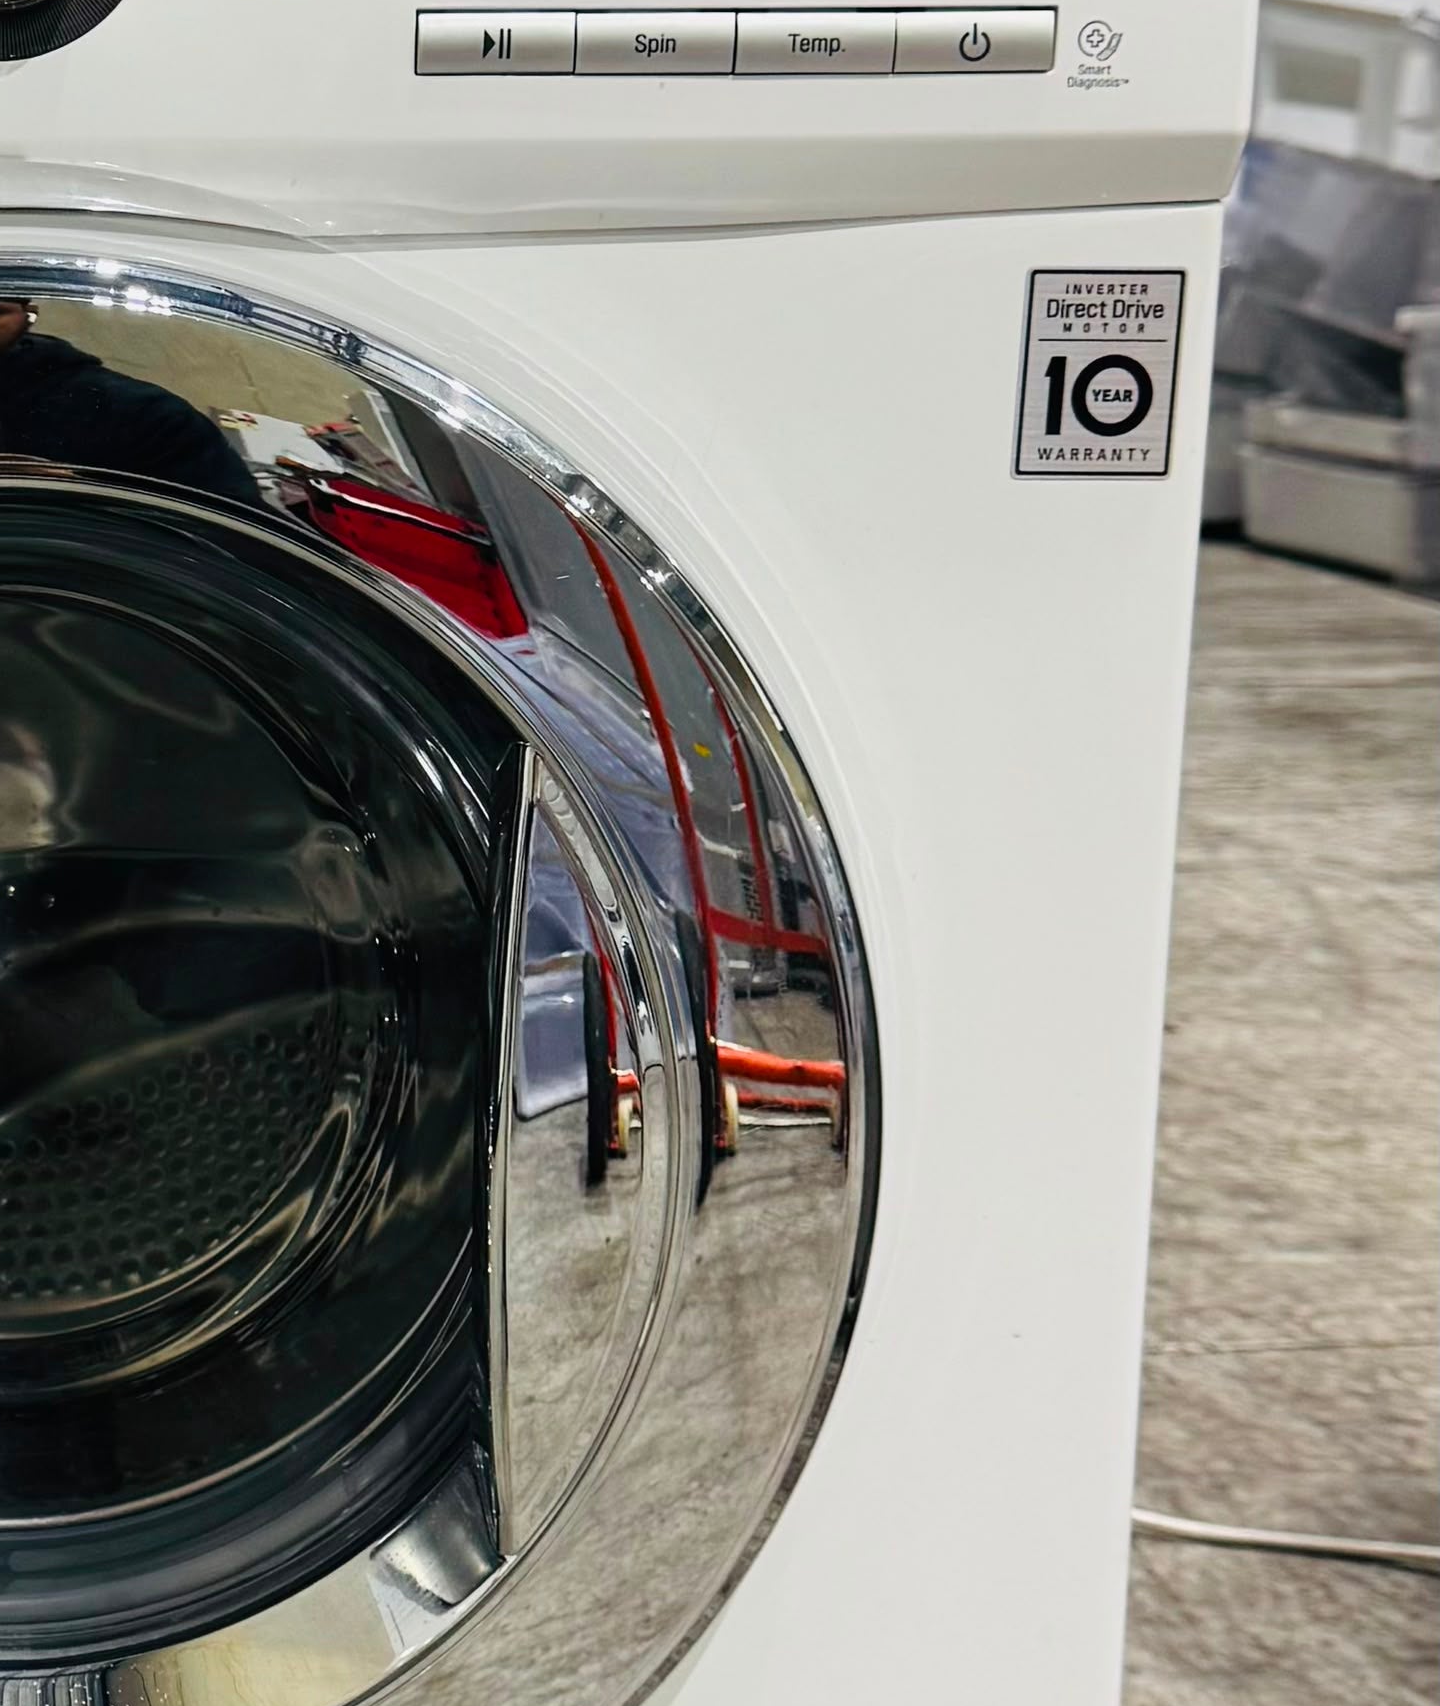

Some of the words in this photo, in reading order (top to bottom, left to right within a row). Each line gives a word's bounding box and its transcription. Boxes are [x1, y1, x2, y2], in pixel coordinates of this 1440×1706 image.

[634, 30, 677, 58] Spin
[787, 30, 847, 57] Temp.
[1078, 64, 1111, 75] Smart
[1065, 283, 1150, 295] INVERTER
[1046, 298, 1108, 319] Direct
[1112, 298, 1165, 319] Drive
[1063, 322, 1146, 333] MOTOR
[1045, 354, 1154, 437] 10
[1092, 389, 1134, 403] YEAR
[1038, 447, 1151, 462] WARRANTY
